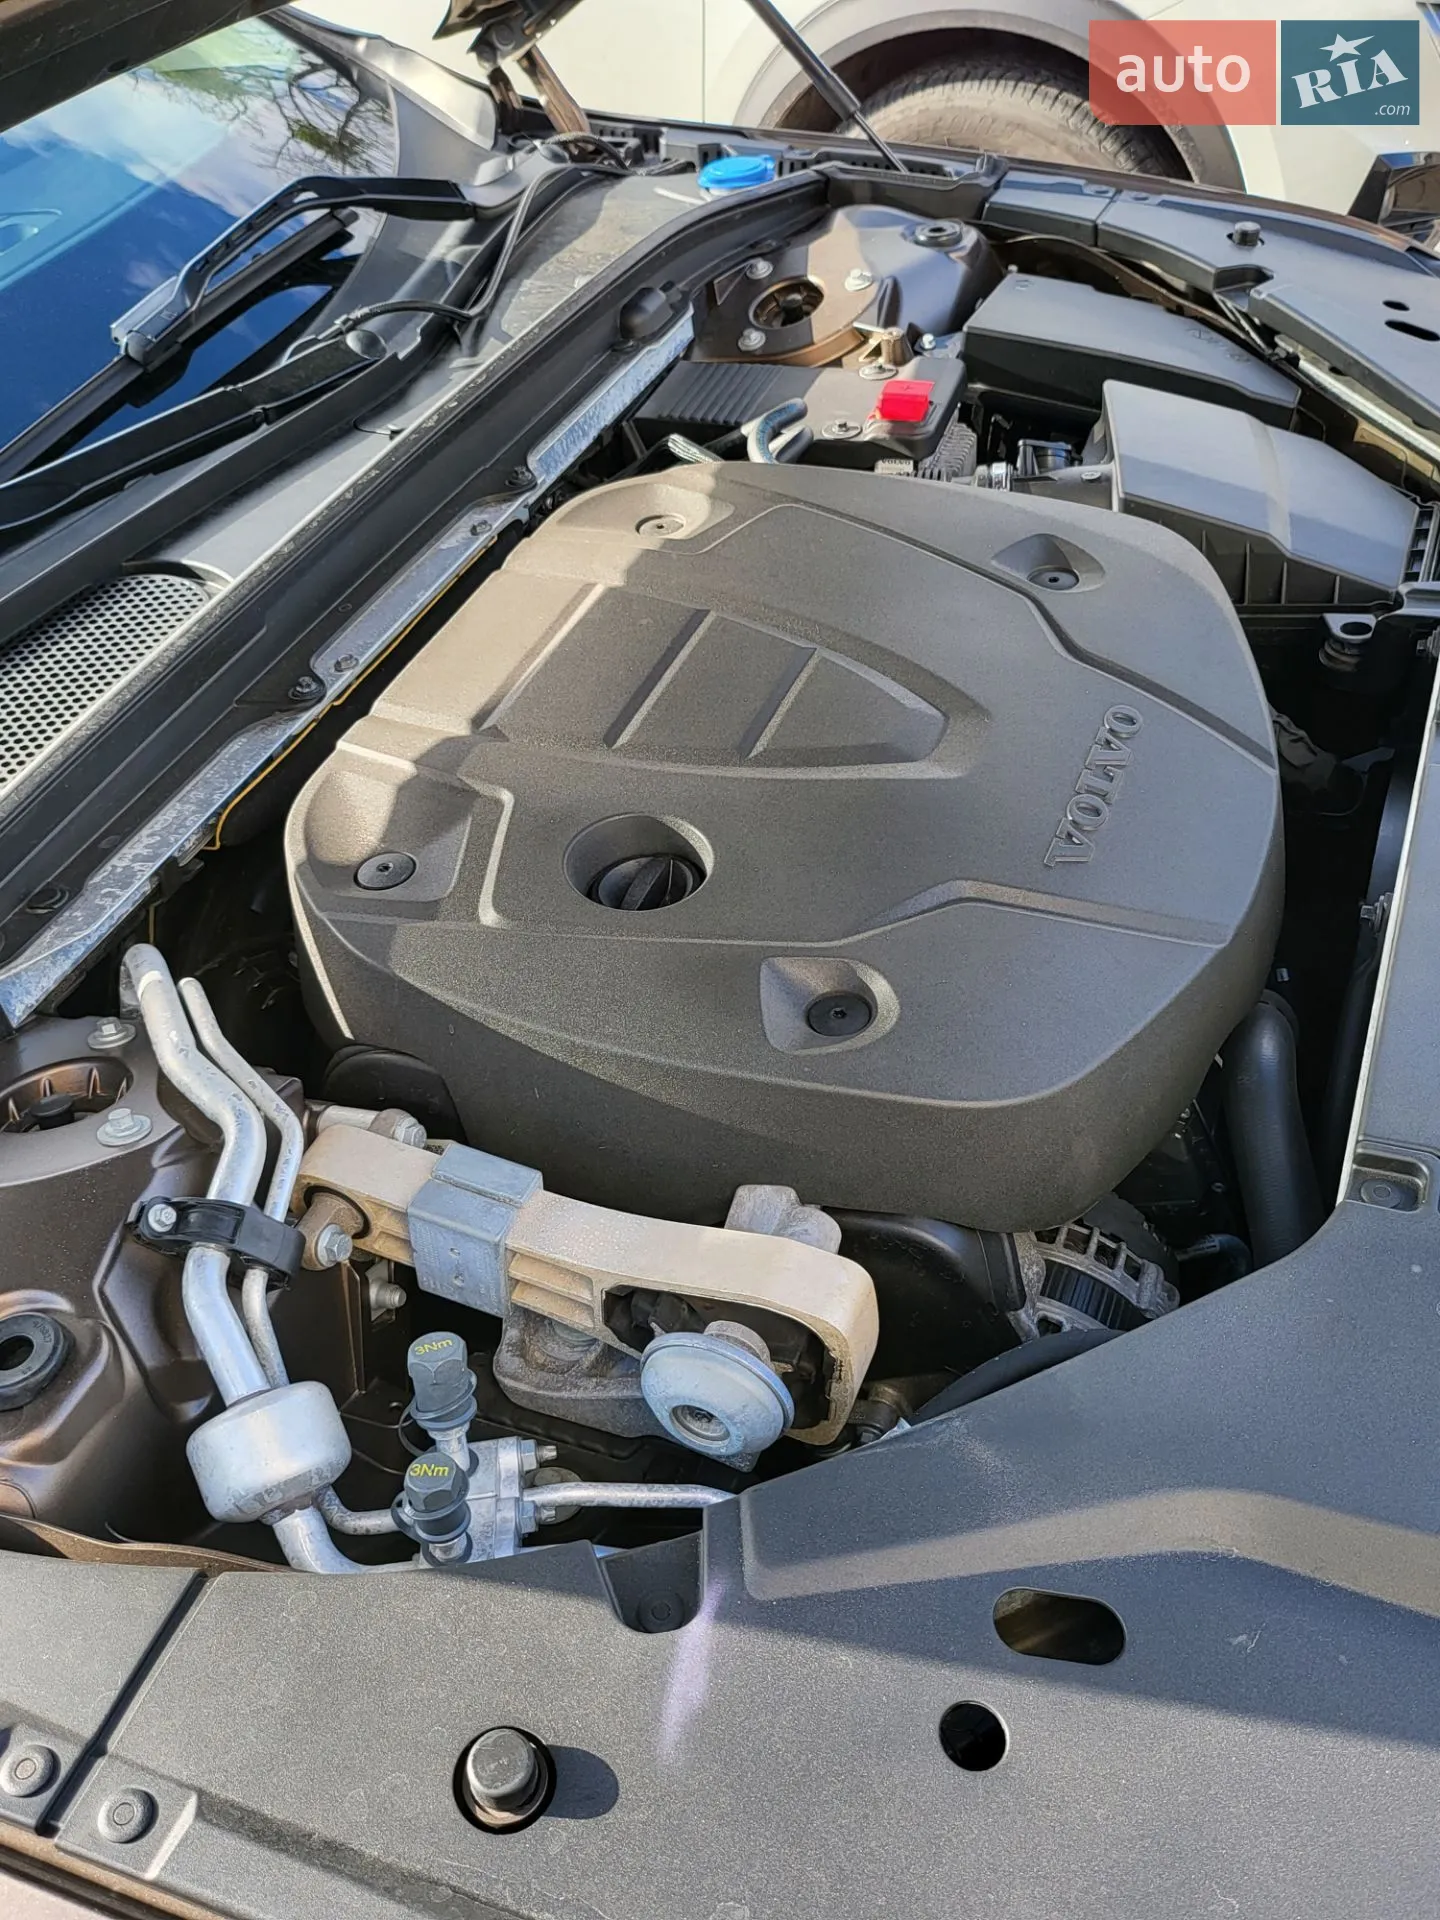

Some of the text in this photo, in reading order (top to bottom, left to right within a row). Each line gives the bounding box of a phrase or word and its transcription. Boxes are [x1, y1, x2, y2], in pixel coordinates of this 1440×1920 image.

[1044, 704, 1144, 868] VOLVO
[415, 1339, 453, 1356] 3Nm
[410, 1463, 449, 1477] 3Nm
